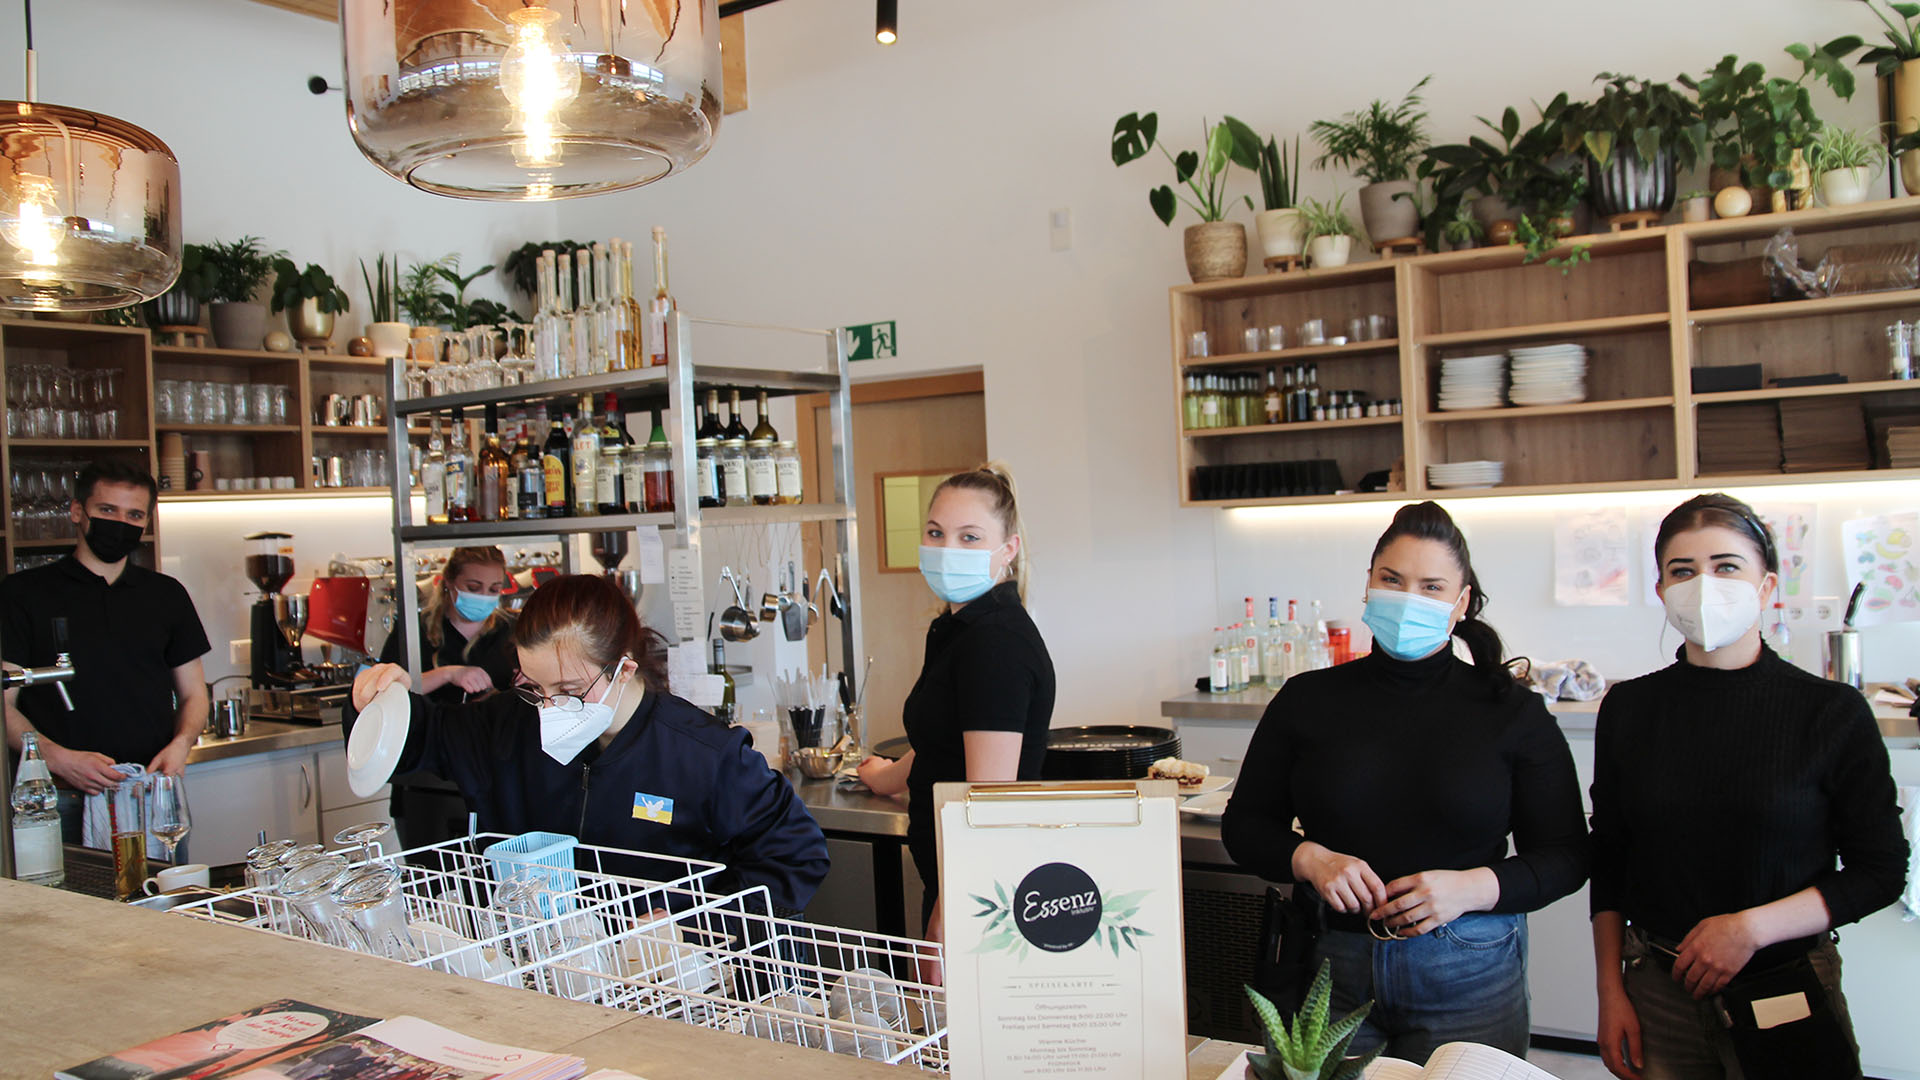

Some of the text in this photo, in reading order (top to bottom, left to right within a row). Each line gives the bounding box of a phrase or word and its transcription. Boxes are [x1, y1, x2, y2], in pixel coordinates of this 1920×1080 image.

[1023, 890, 1097, 922] Essenz
[1028, 981, 1094, 989] SPEISEKARTE
[1038, 1014, 1077, 1022] Donnerstag
